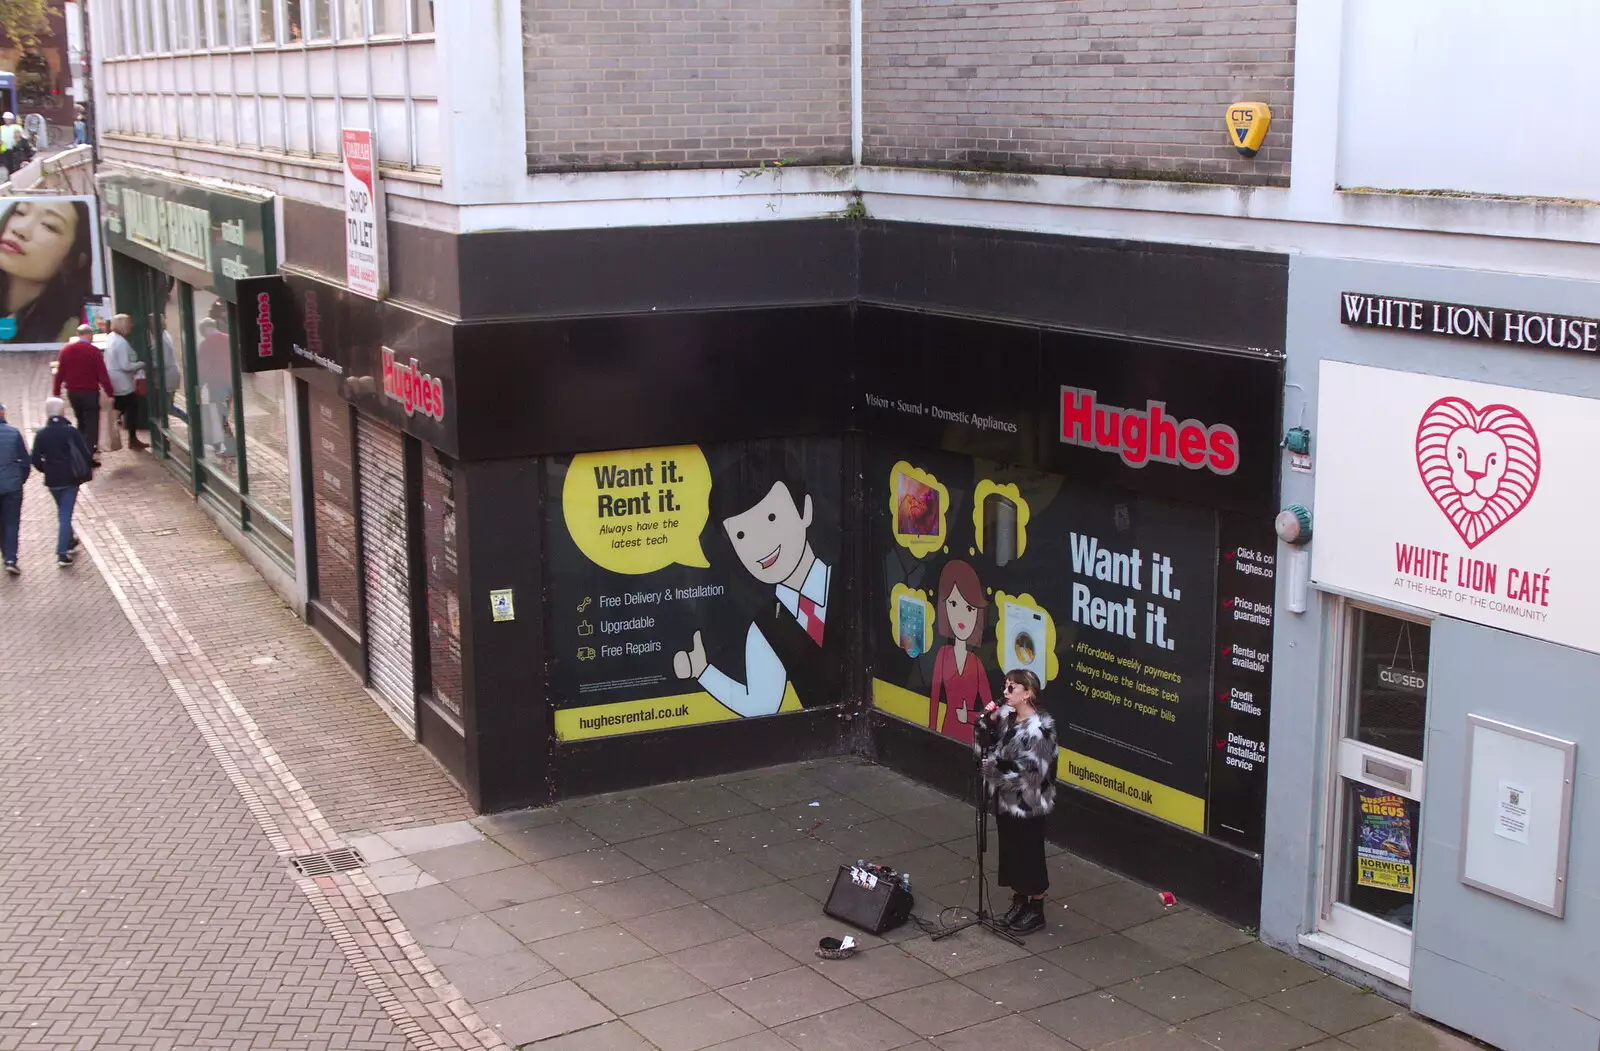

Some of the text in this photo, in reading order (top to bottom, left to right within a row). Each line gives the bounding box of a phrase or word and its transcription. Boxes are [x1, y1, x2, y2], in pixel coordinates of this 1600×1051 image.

[1232, 110, 1253, 121] CTS
[350, 189, 368, 214] SHOP
[348, 218, 373, 249] TO LET
[258, 292, 274, 357] Hughes
[1343, 294, 1599, 352] WHITE LION HOUSE
[382, 345, 445, 423] Hughes
[865, 393, 1018, 433] Vision Sound Domestic Appliances
[1060, 384, 1240, 476] Hughes
[594, 460, 684, 490] Want it.
[598, 489, 681, 518] Rent it.
[600, 518, 679, 536] Always have the
[612, 534, 668, 549] latest tech
[1070, 532, 1181, 601] Want it.
[1237, 547, 1255, 561] Click
[1256, 552, 1262, 562] &
[1396, 542, 1550, 607] WHITE LION CAFÉ
[600, 584, 724, 608] Free Delivery & Installation
[1234, 596, 1252, 610] Price
[1394, 577, 1548, 622] AT THE HEART OF THE COMMUNITY
[600, 616, 655, 634] Upgradable
[1072, 582, 1175, 651] Rent it.
[1234, 610, 1270, 626] guarantee
[601, 640, 662, 658] Free Repairs
[1232, 644, 1256, 660] Rental
[1076, 642, 1182, 684] Affordable weekly payments
[1232, 656, 1265, 673] available
[1076, 662, 1180, 704] Always have the latest tech
[1231, 688, 1253, 702] Credit
[1076, 680, 1176, 723] Say goodbye to repair bills
[1230, 698, 1262, 716] facilities
[579, 704, 689, 730] hughesrental.co.uk
[1228, 732, 1266, 752] Delivery &
[1226, 756, 1253, 771] service
[1068, 760, 1153, 804] hughesrental.co.uk
[1360, 802, 1404, 818] CIRCUS
[1360, 858, 1410, 872] NORWICH
